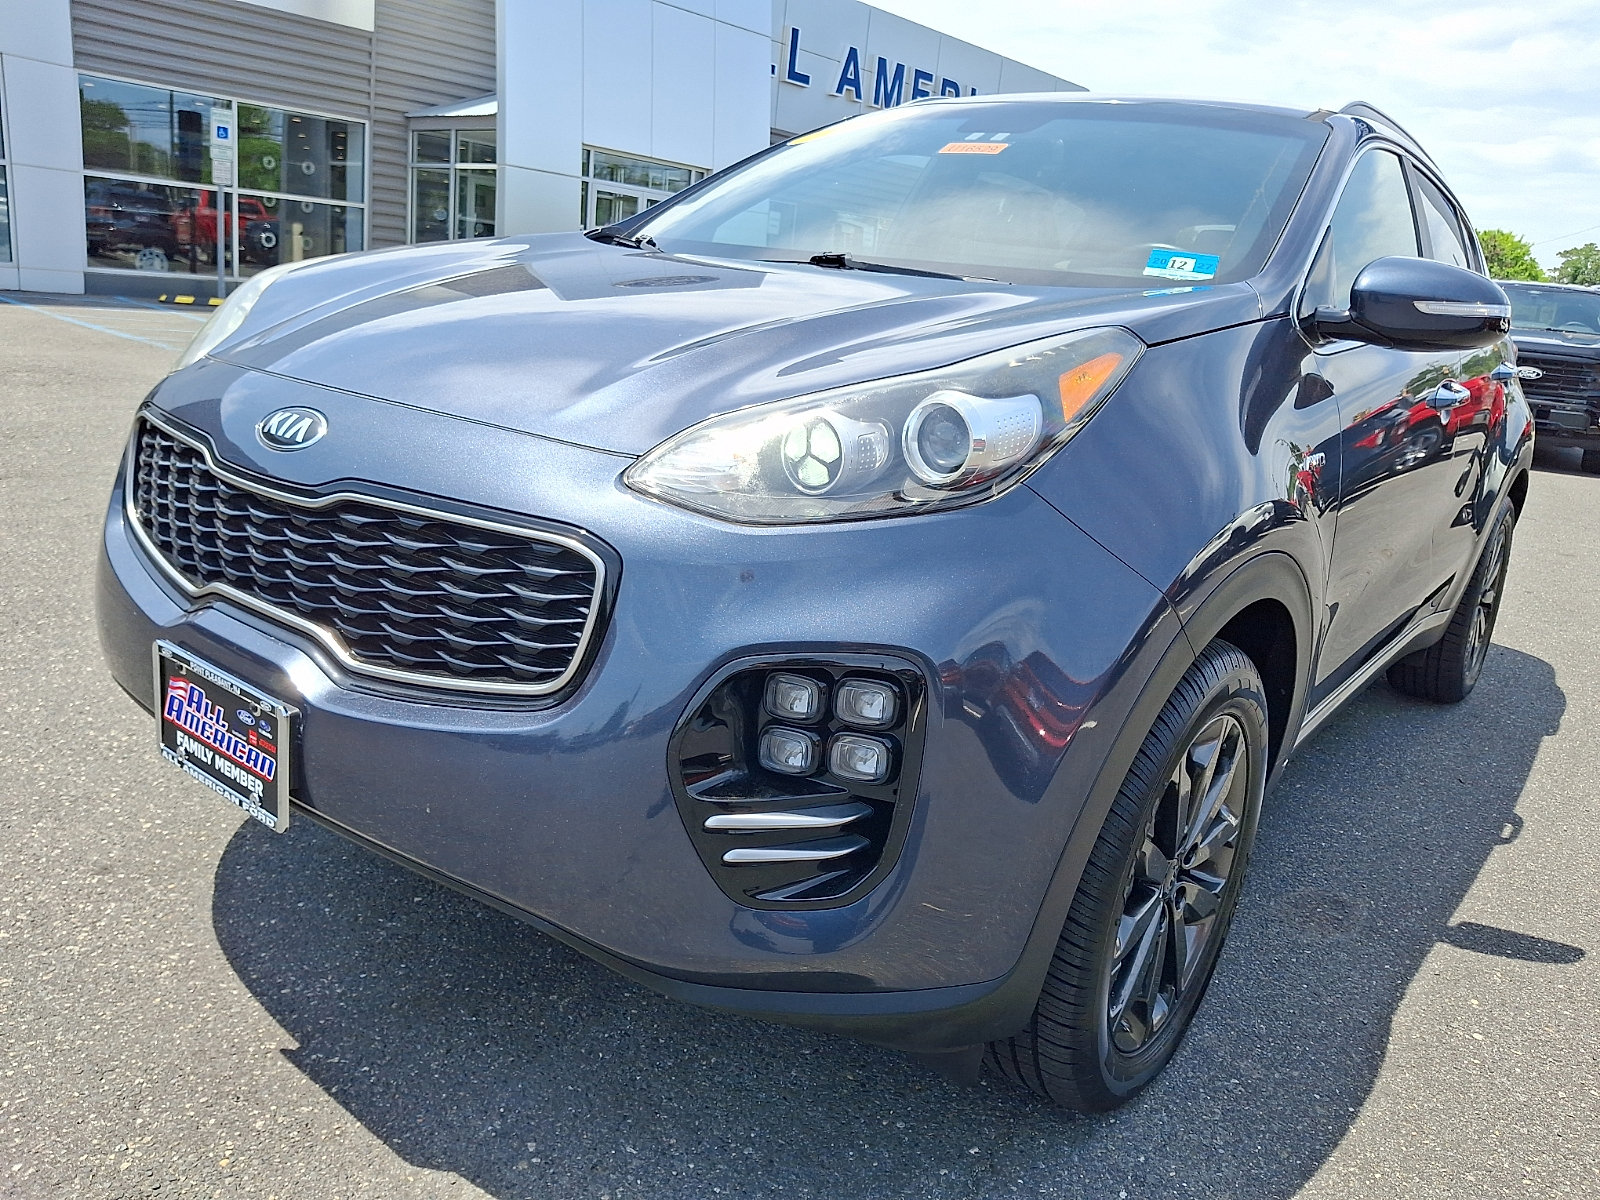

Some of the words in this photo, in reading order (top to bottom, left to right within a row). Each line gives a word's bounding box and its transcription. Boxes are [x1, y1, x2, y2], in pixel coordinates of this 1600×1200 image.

[834, 46, 979, 109] AME
[1169, 259, 1188, 270] 12
[262, 411, 314, 443] KIA
[166, 694, 276, 780] AMERICAN
[187, 684, 228, 730] ALL
[162, 750, 181, 767] ALL
[183, 764, 240, 806] AMERICAN
[242, 802, 276, 828] FORD
[176, 730, 214, 766] FAMILY
[214, 756, 264, 797] MEMBER
